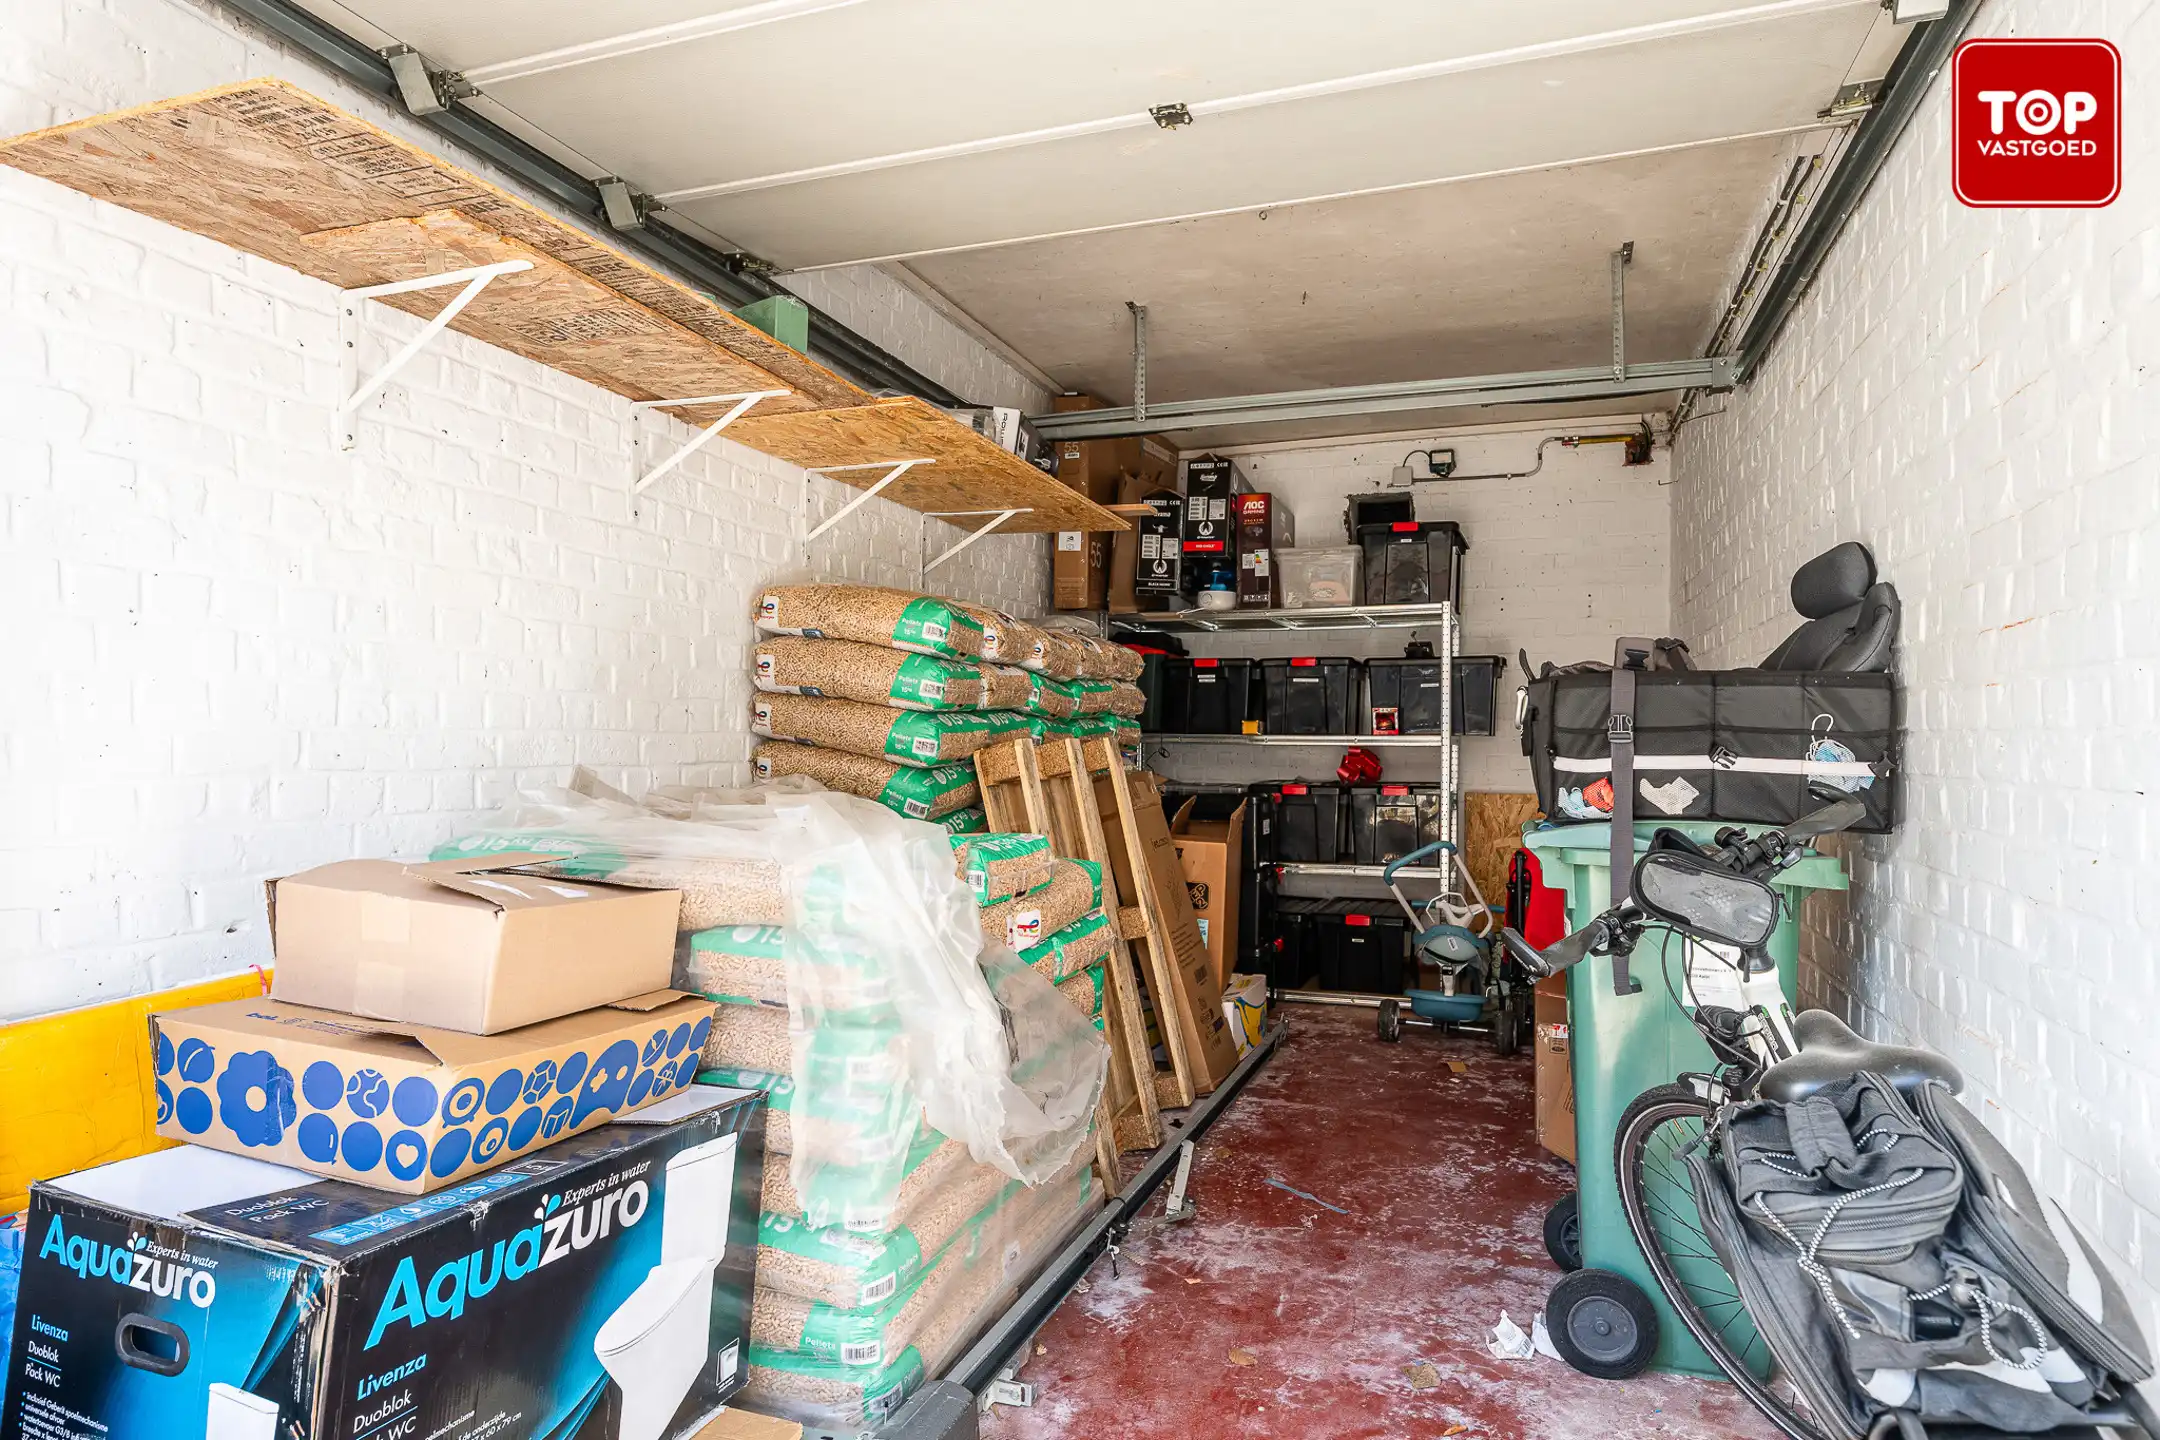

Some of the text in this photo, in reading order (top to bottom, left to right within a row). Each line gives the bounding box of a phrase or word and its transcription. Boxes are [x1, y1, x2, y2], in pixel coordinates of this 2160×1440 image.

[1064, 441, 1079, 453] 55
[1243, 500, 1265, 510] AOC
[1090, 541, 1102, 569] 55
[562, 1158, 652, 1208] Experts in water
[224, 1196, 299, 1216] Duoblok
[249, 1200, 330, 1223] Pack WC
[39, 1213, 217, 1309] Aquazuro
[146, 1240, 219, 1270] Experts in water
[363, 1178, 650, 1352] Aquazuro
[31, 1313, 69, 1342] Livenza
[28, 1340, 59, 1363] Duoblok
[805, 1336, 836, 1351] Pellets
[25, 1363, 61, 1388] Pack WC
[357, 1354, 428, 1401] Livenza
[353, 1389, 412, 1434] Duoblok
[424, 1409, 475, 1440] oelmechanisme
[472, 1410, 506, 1436] onderzijde
[485, 1426, 496, 1438] 60
[496, 1424, 501, 1432] x
[501, 1416, 512, 1429] 79
[512, 1411, 522, 1422] cm
[388, 1416, 417, 1440] WC
